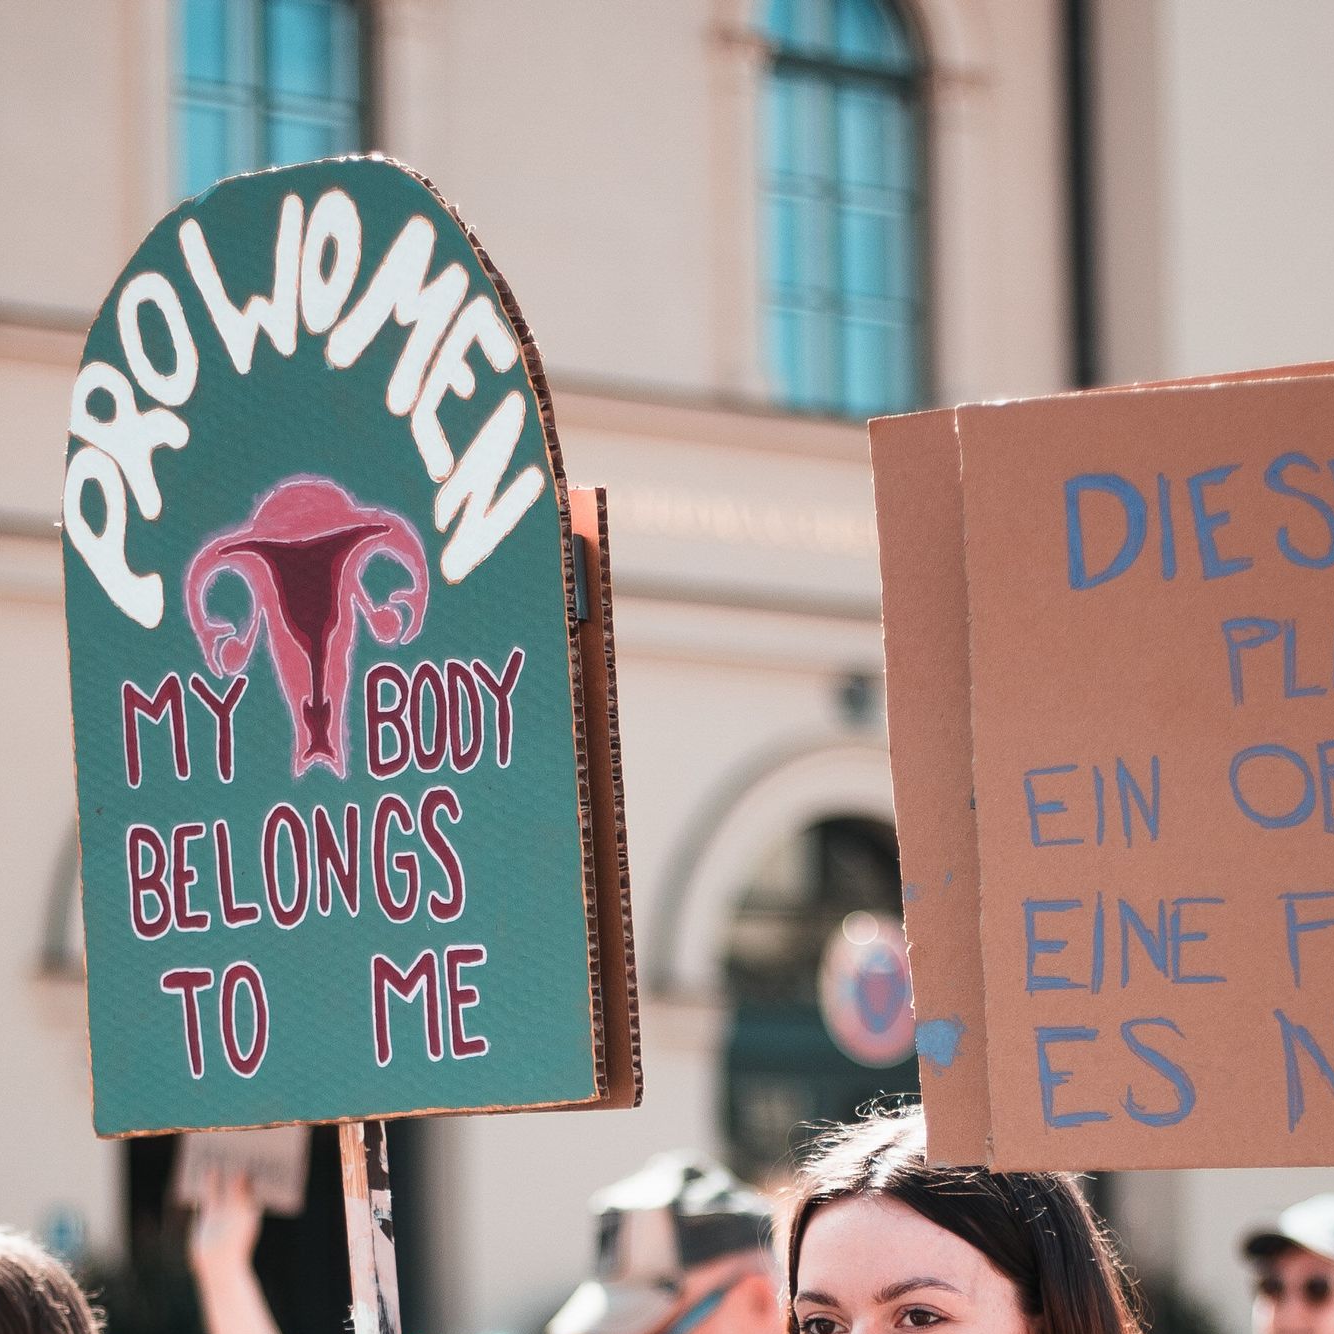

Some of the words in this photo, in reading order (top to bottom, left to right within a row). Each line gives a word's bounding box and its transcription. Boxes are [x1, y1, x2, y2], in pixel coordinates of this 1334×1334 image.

[64, 270, 200, 630] PRO
[178, 187, 545, 587] WOMEN
[123, 671, 249, 790] MY
[365, 647, 525, 778] BODY
[125, 786, 467, 941] BELONGS
[1023, 755, 1161, 848] EIN
[160, 960, 269, 1080] TO
[370, 943, 491, 1069] ME
[1023, 894, 1227, 995] EINE
[1035, 1016, 1197, 1131] ES
